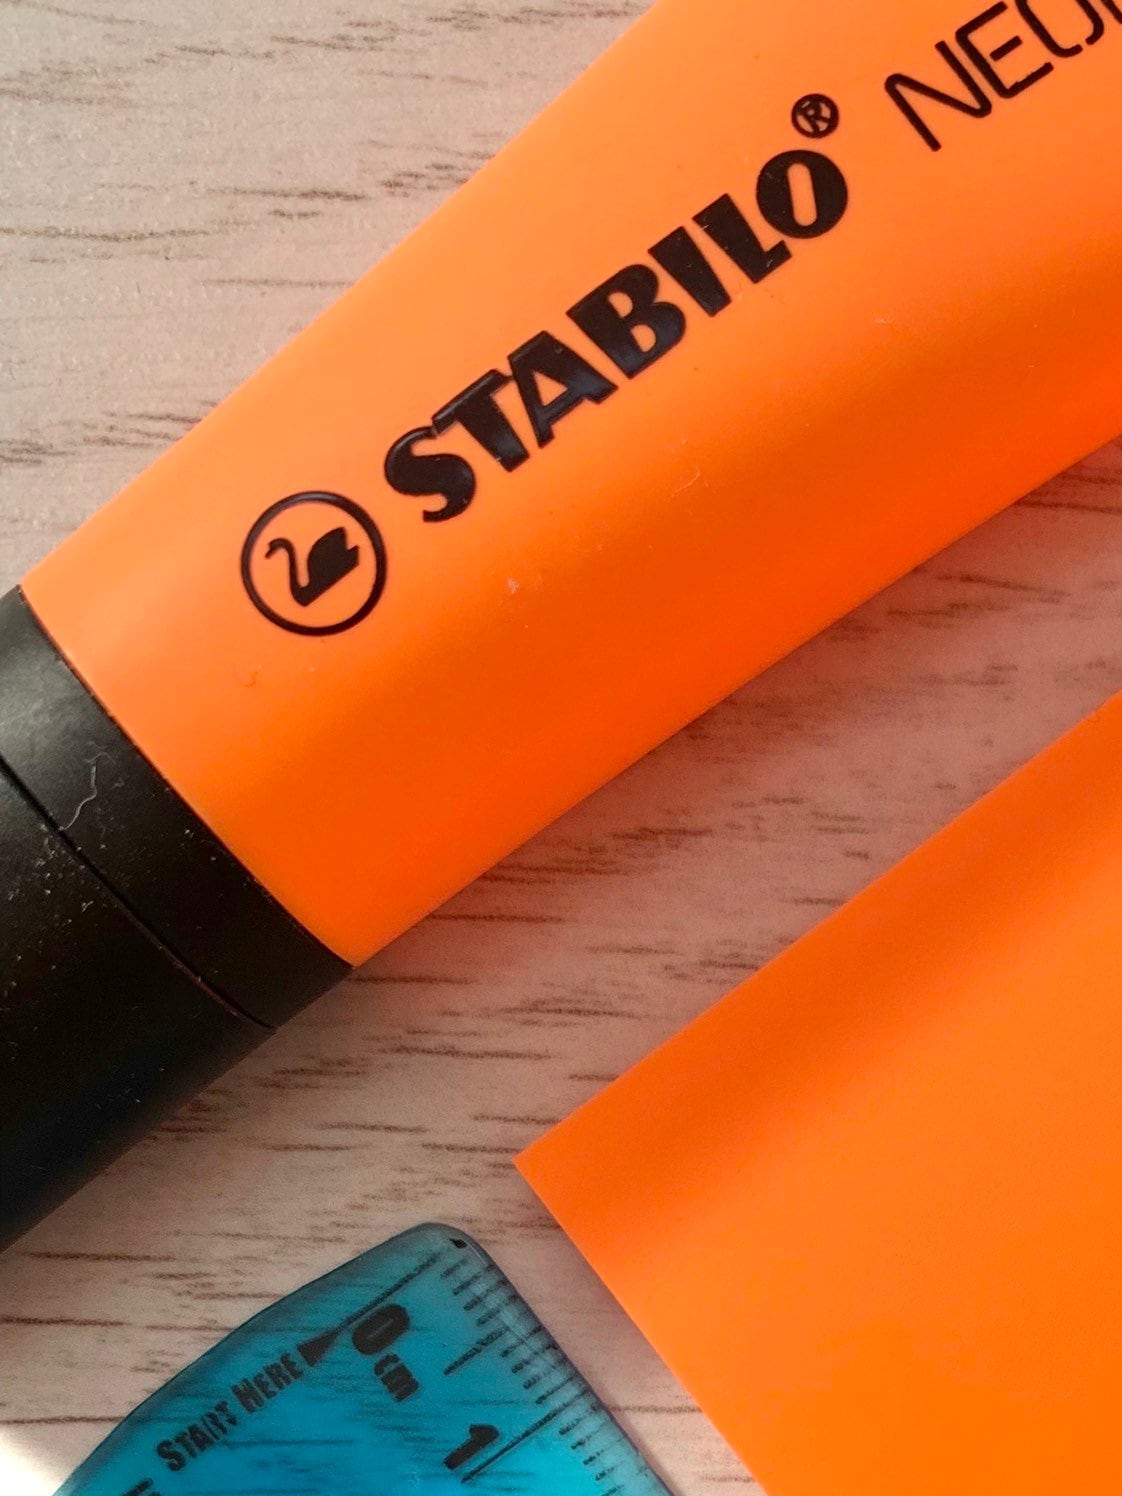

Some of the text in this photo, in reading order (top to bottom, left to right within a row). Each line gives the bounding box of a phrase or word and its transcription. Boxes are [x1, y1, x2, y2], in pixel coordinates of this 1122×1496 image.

[352, 1304, 410, 1355] 0
[157, 1353, 303, 1471] START HERE
[443, 1424, 499, 1470] 1
